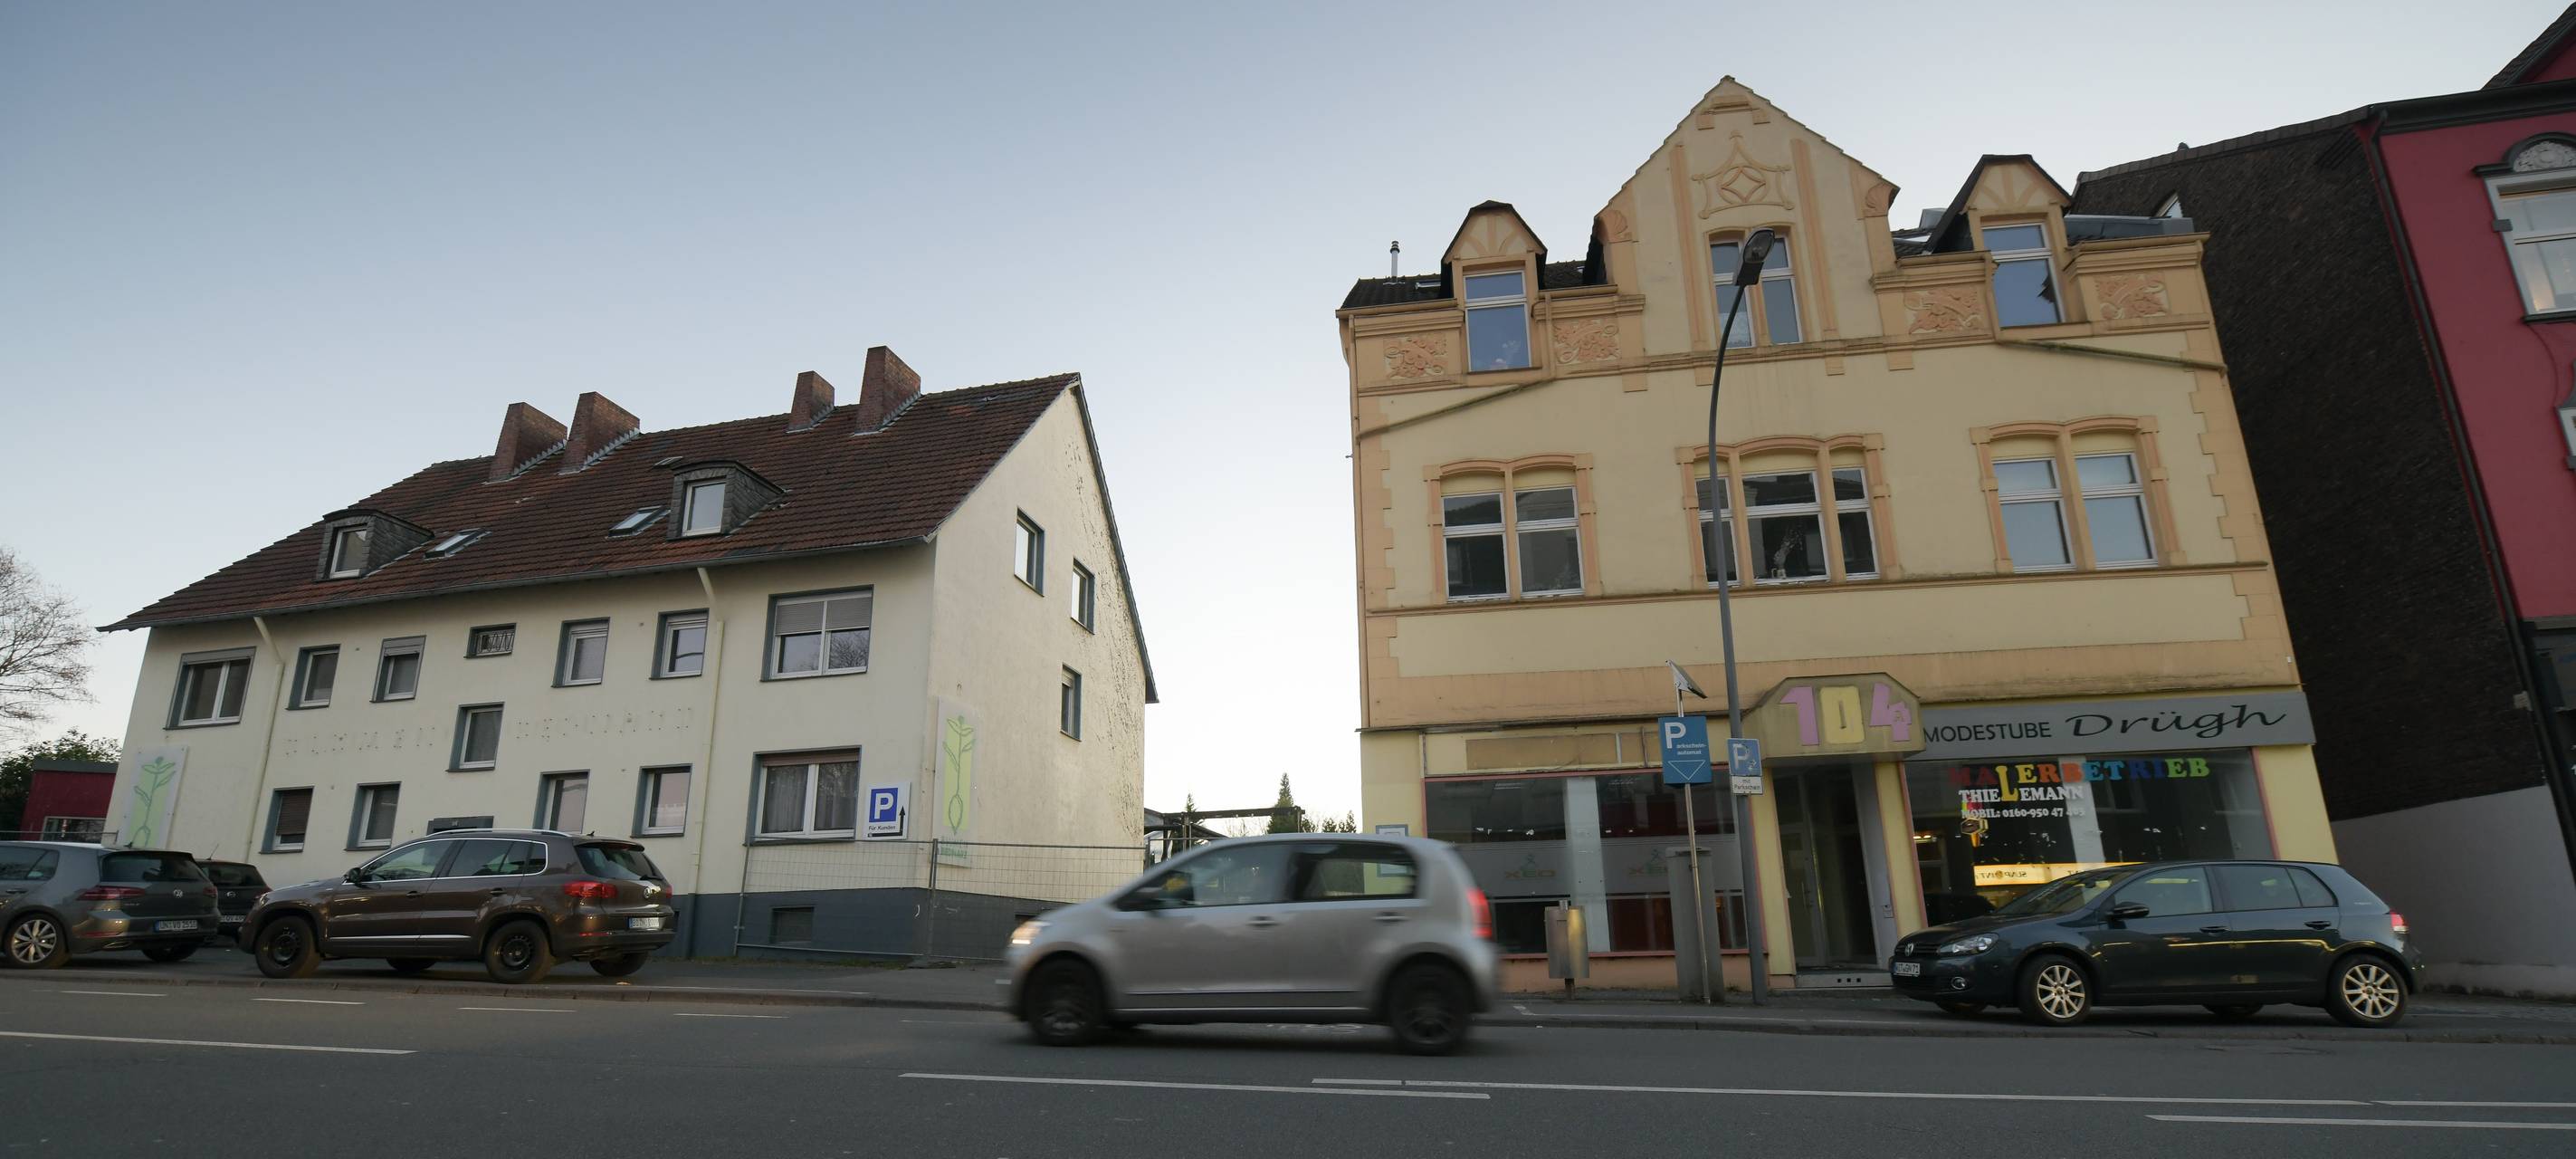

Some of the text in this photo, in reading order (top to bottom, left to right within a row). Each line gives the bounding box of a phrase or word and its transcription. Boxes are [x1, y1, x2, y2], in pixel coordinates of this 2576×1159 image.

[1779, 683, 1912, 746] 104
[1923, 704, 2287, 742] MODESTUBE Drügh
[1665, 722, 1686, 749] P
[1948, 758, 2209, 797] MALERBETRIEB
[1958, 780, 2085, 802] THIELEMANN
[873, 792, 894, 819] P
[1961, 808, 2001, 819] MOBIL:
[2002, 807, 2049, 818] 0160-950
[2051, 807, 2065, 818] 47
